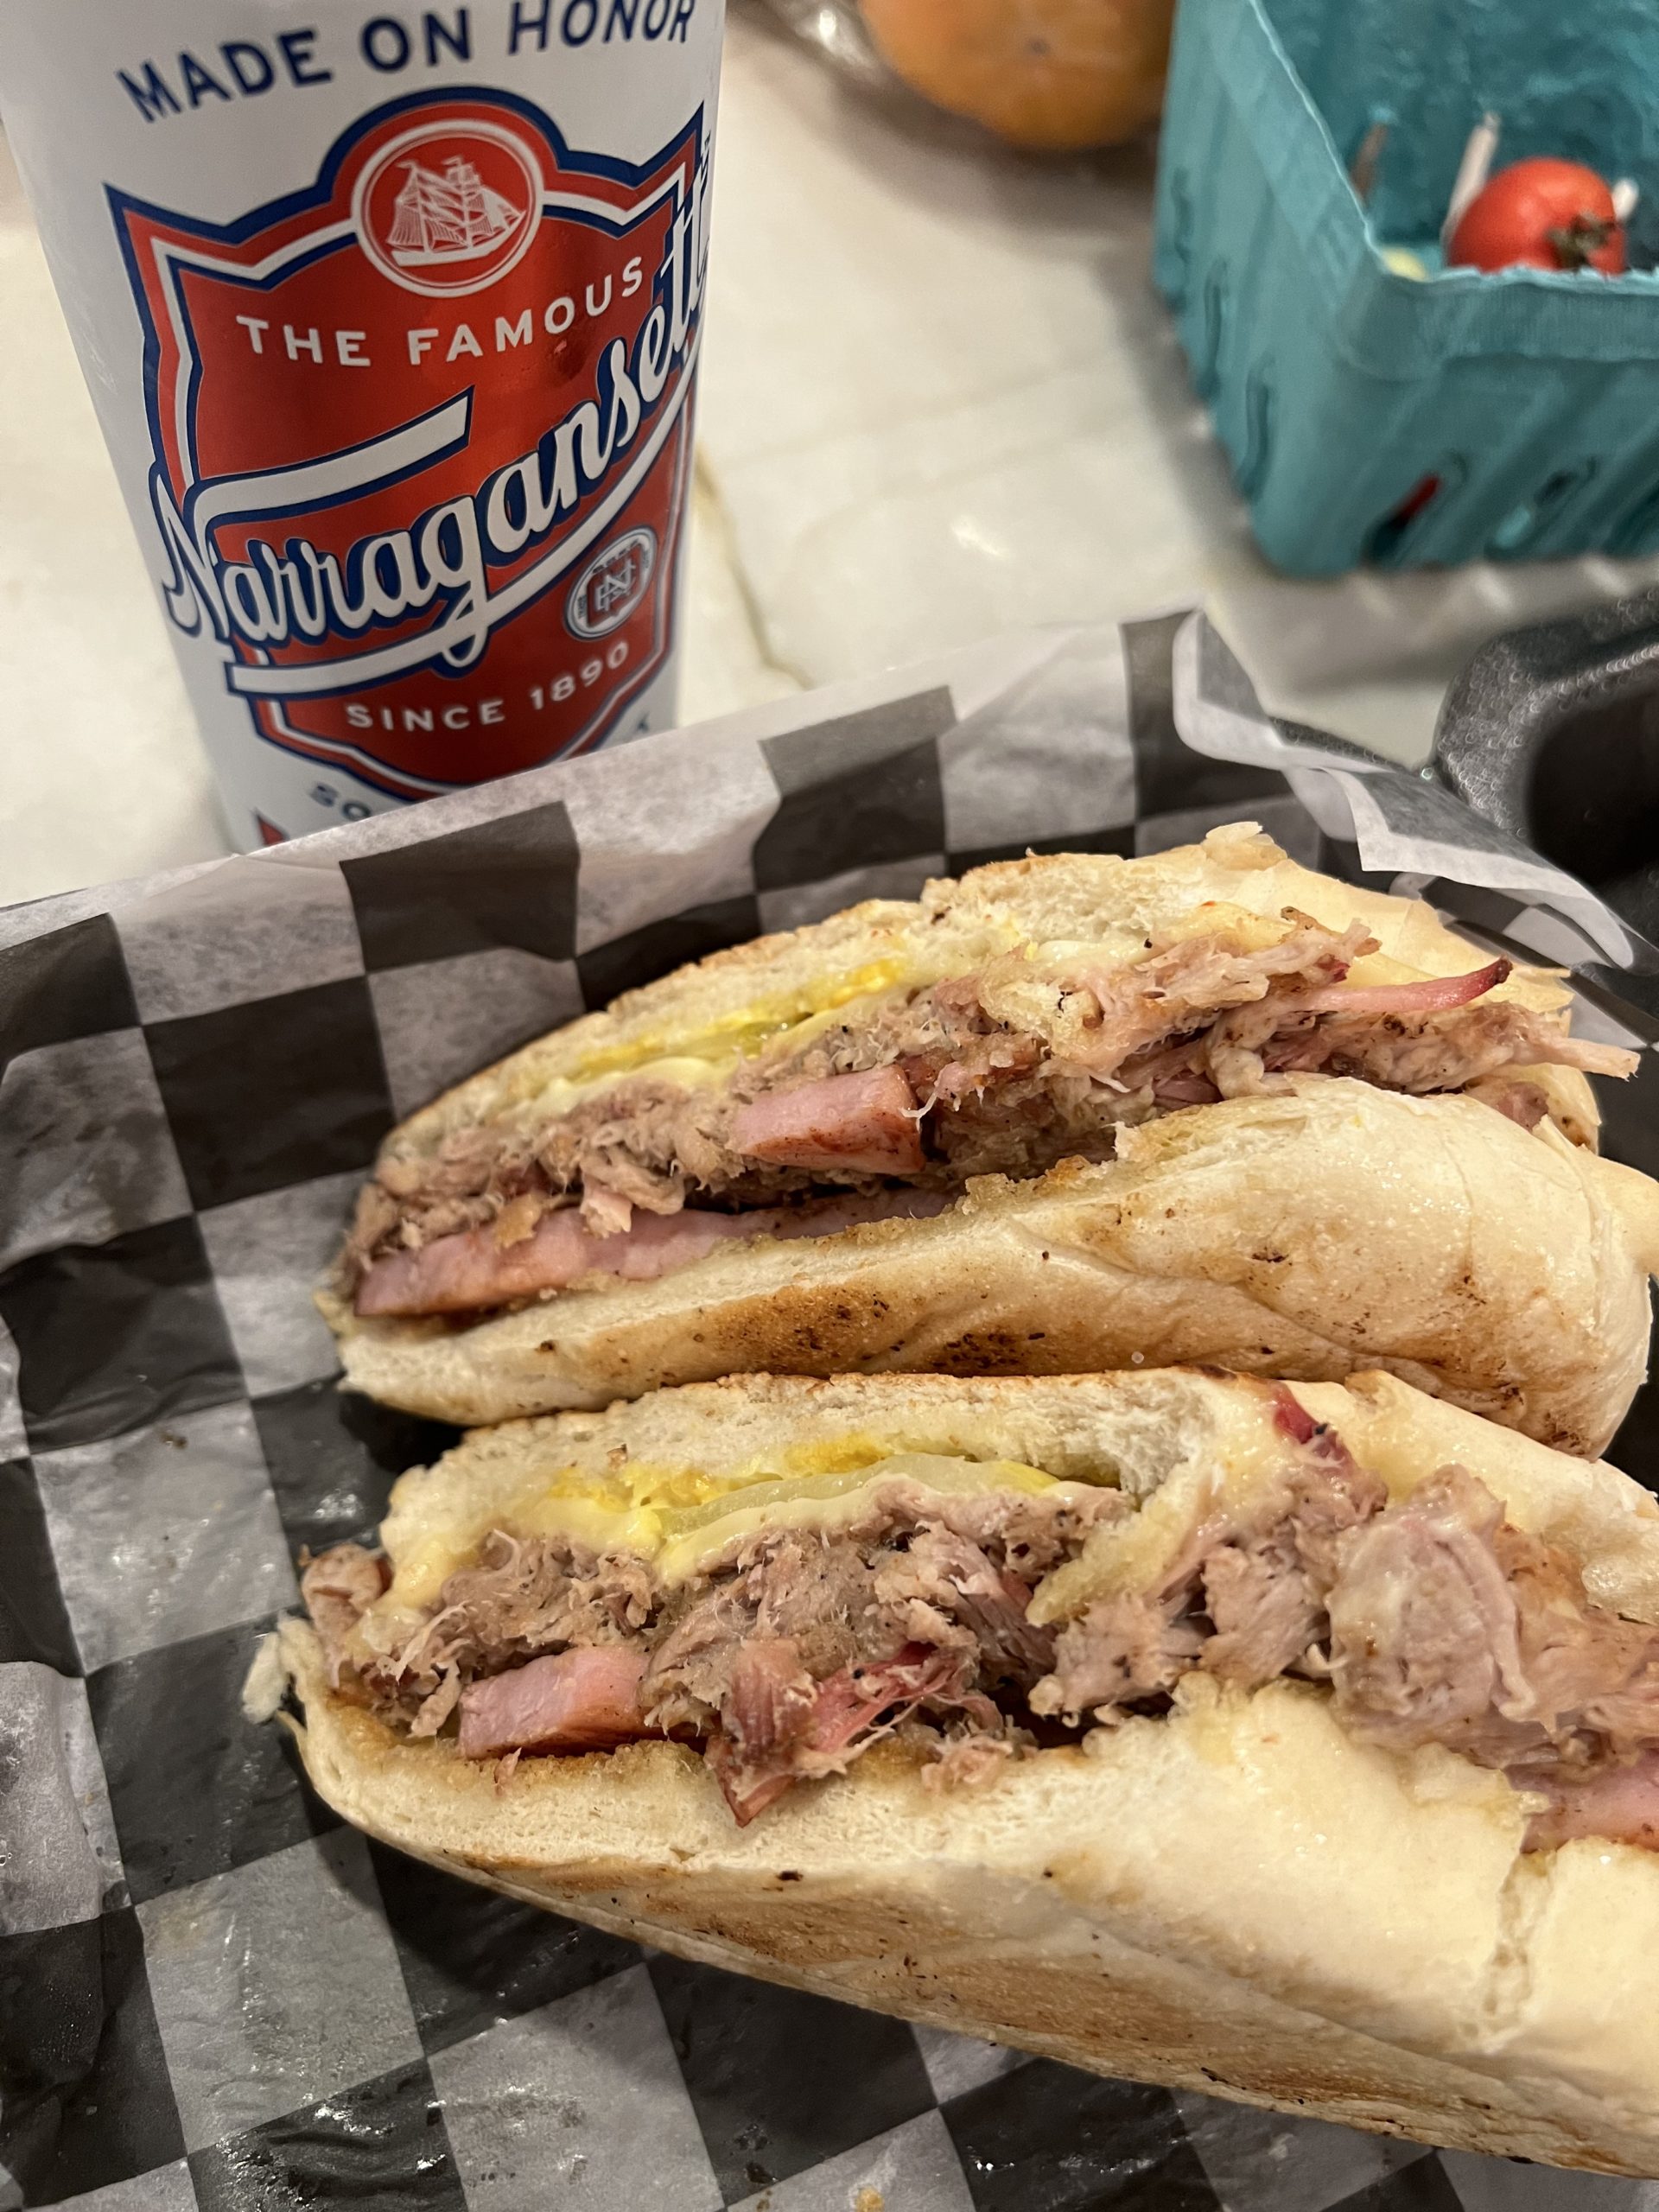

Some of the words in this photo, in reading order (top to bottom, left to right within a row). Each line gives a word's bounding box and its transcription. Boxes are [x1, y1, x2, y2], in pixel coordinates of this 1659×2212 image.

[117, 29, 334, 124] MADE
[359, 8, 472, 73] ON
[508, 0, 698, 54] HONOR
[236, 315, 372, 368] THE
[409, 256, 645, 365] FAMOUS
[156, 156, 710, 671] Narragansett
[346, 702, 505, 733] SINCE
[531, 640, 629, 710] 1890
[310, 782, 373, 821] SO
